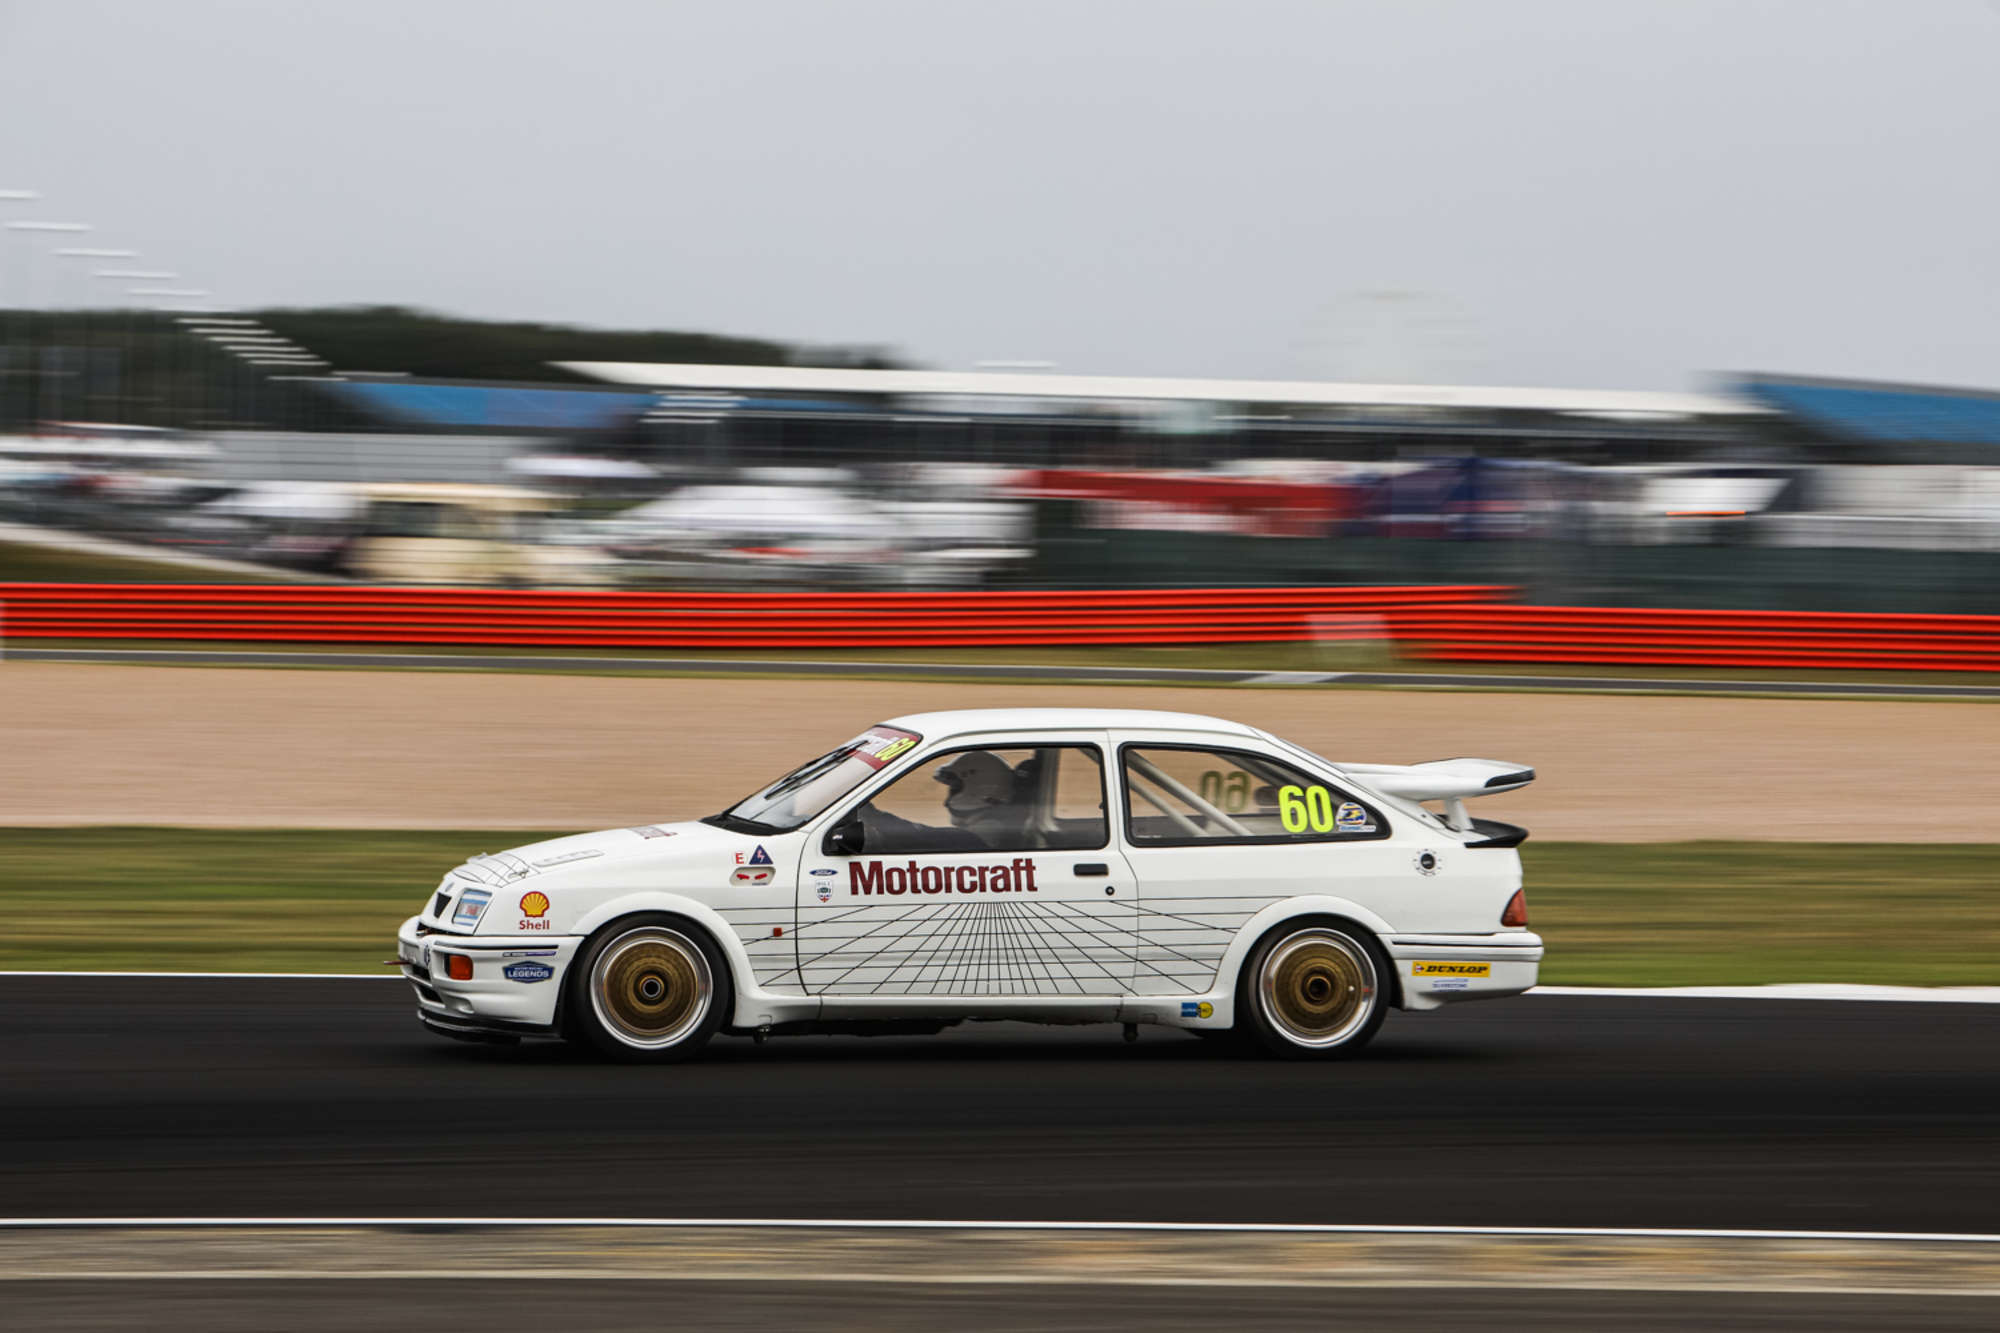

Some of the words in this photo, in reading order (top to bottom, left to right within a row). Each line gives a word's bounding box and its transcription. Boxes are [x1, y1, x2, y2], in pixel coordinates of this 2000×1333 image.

[1279, 785, 1334, 833] 60
[735, 851, 745, 864] E
[848, 858, 1039, 896] Motorcraft
[519, 920, 550, 930] Shell
[507, 969, 549, 977] LEGENDS
[1425, 965, 1489, 974] DUNLOP
